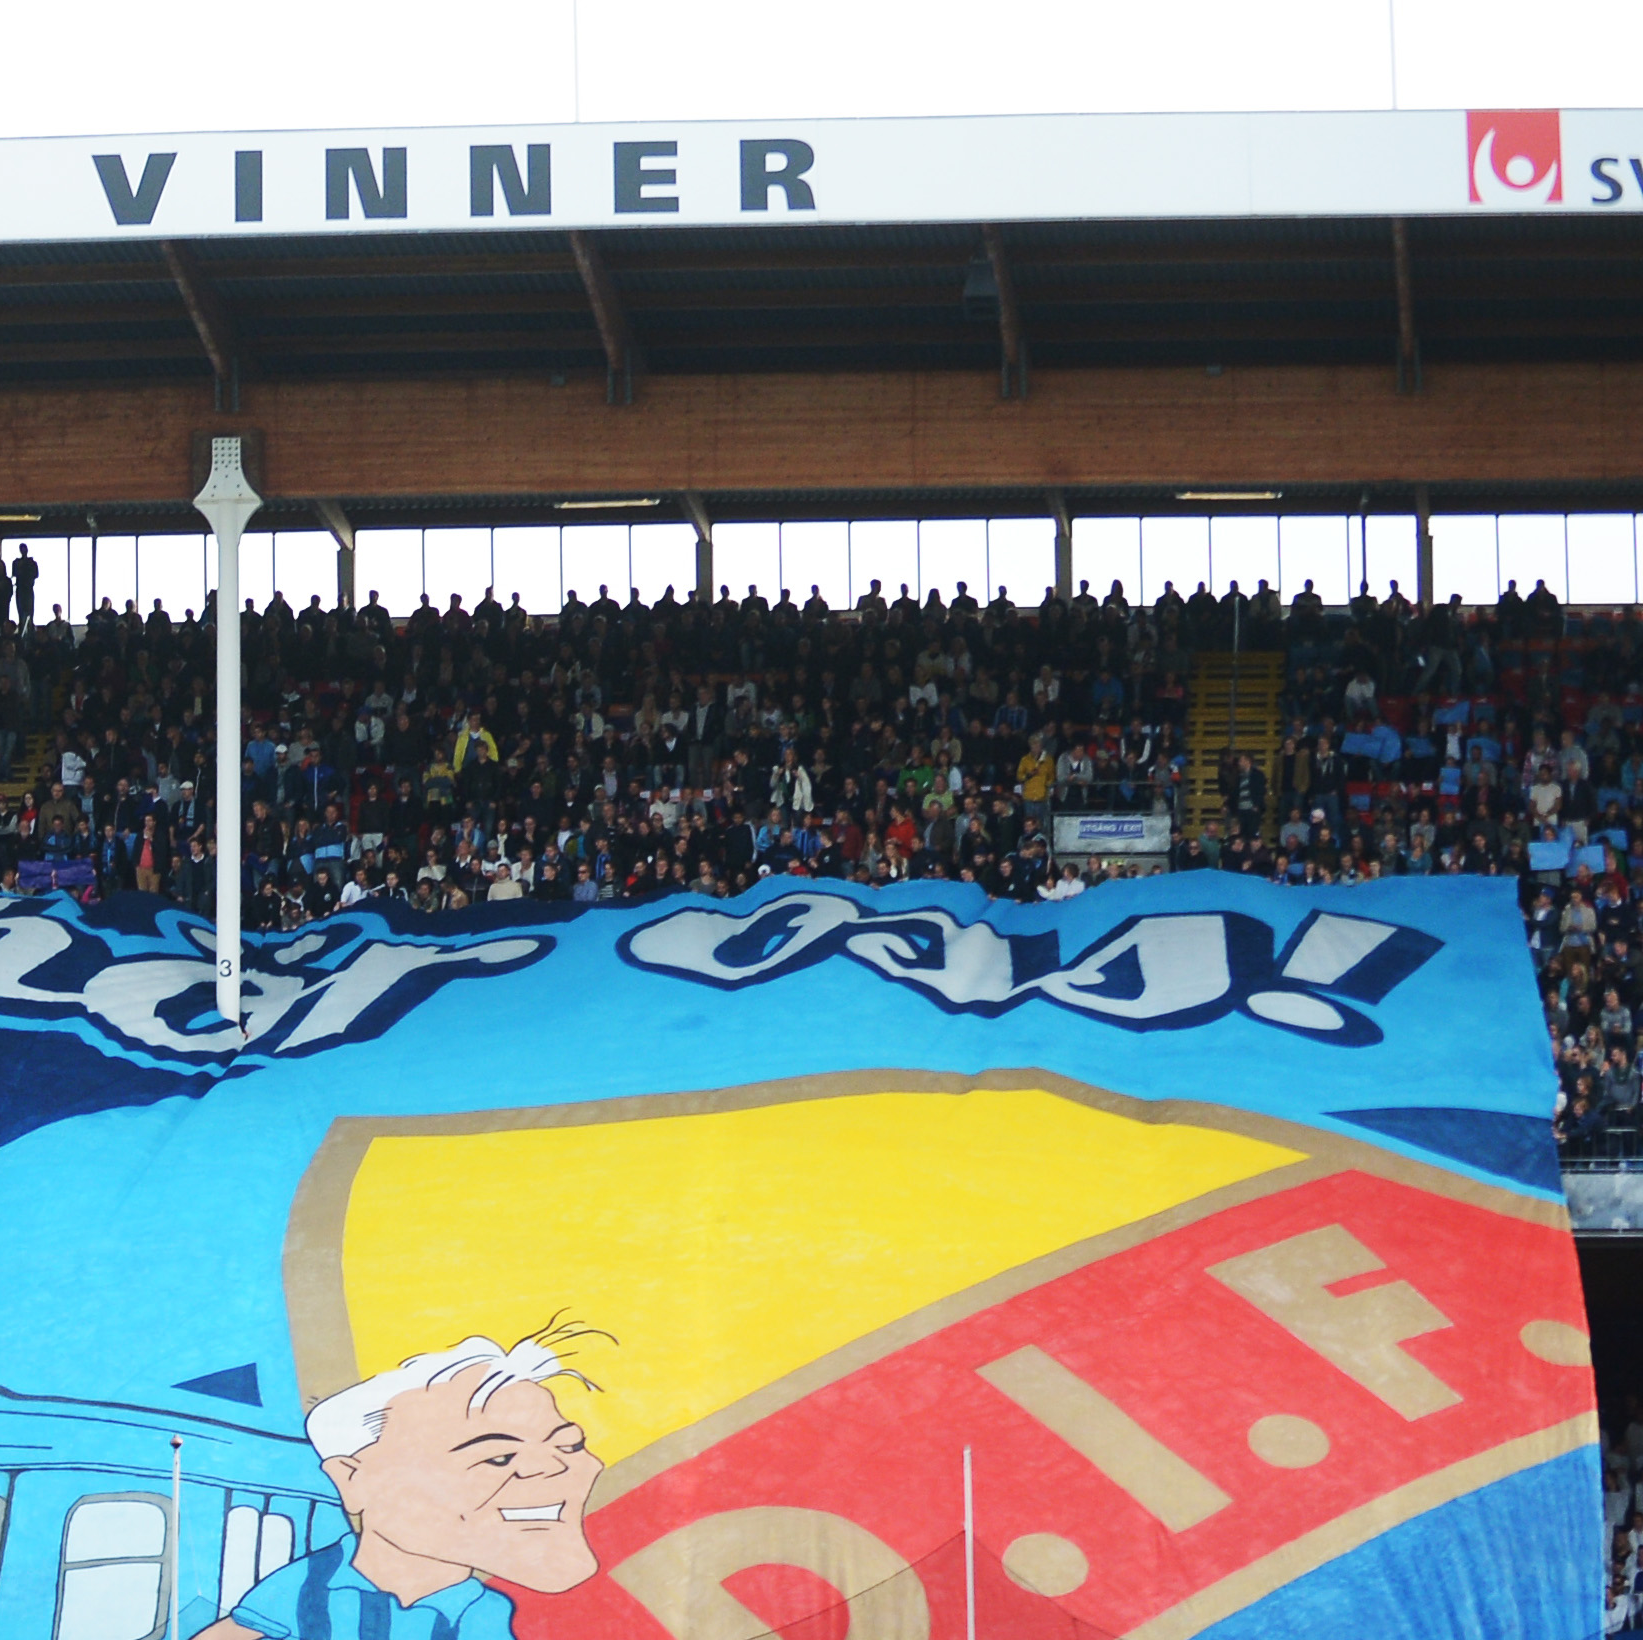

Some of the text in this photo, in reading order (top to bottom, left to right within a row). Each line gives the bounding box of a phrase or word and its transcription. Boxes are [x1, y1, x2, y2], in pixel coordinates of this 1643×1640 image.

[92, 138, 818, 226] VINNER
[1590, 157, 1643, 203] S
[220, 959, 232, 977] 3
[616, 890, 1445, 1047] Oss!
